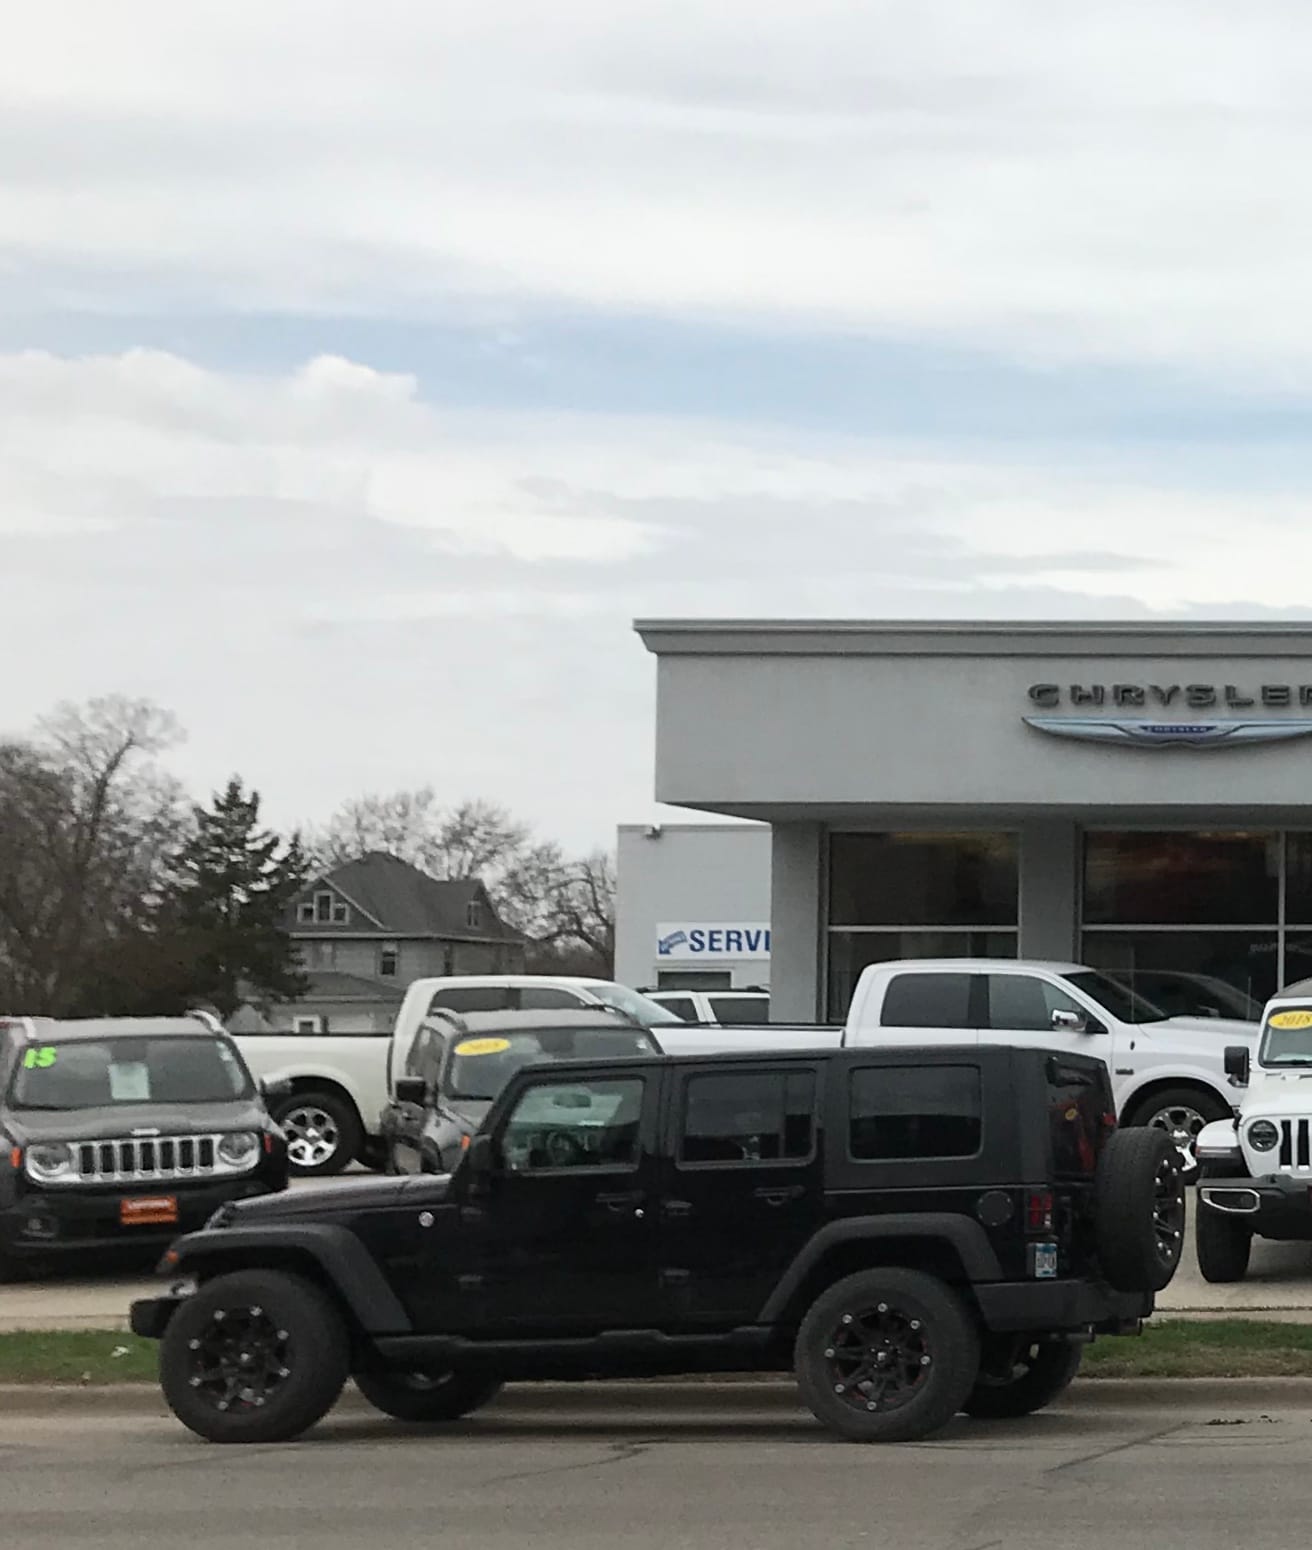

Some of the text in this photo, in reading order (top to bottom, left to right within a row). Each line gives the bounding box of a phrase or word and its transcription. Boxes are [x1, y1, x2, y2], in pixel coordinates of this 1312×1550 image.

[688, 930, 771, 953] SERVI
[1279, 1013, 1312, 1026] 2018
[24, 1047, 57, 1068] 15
